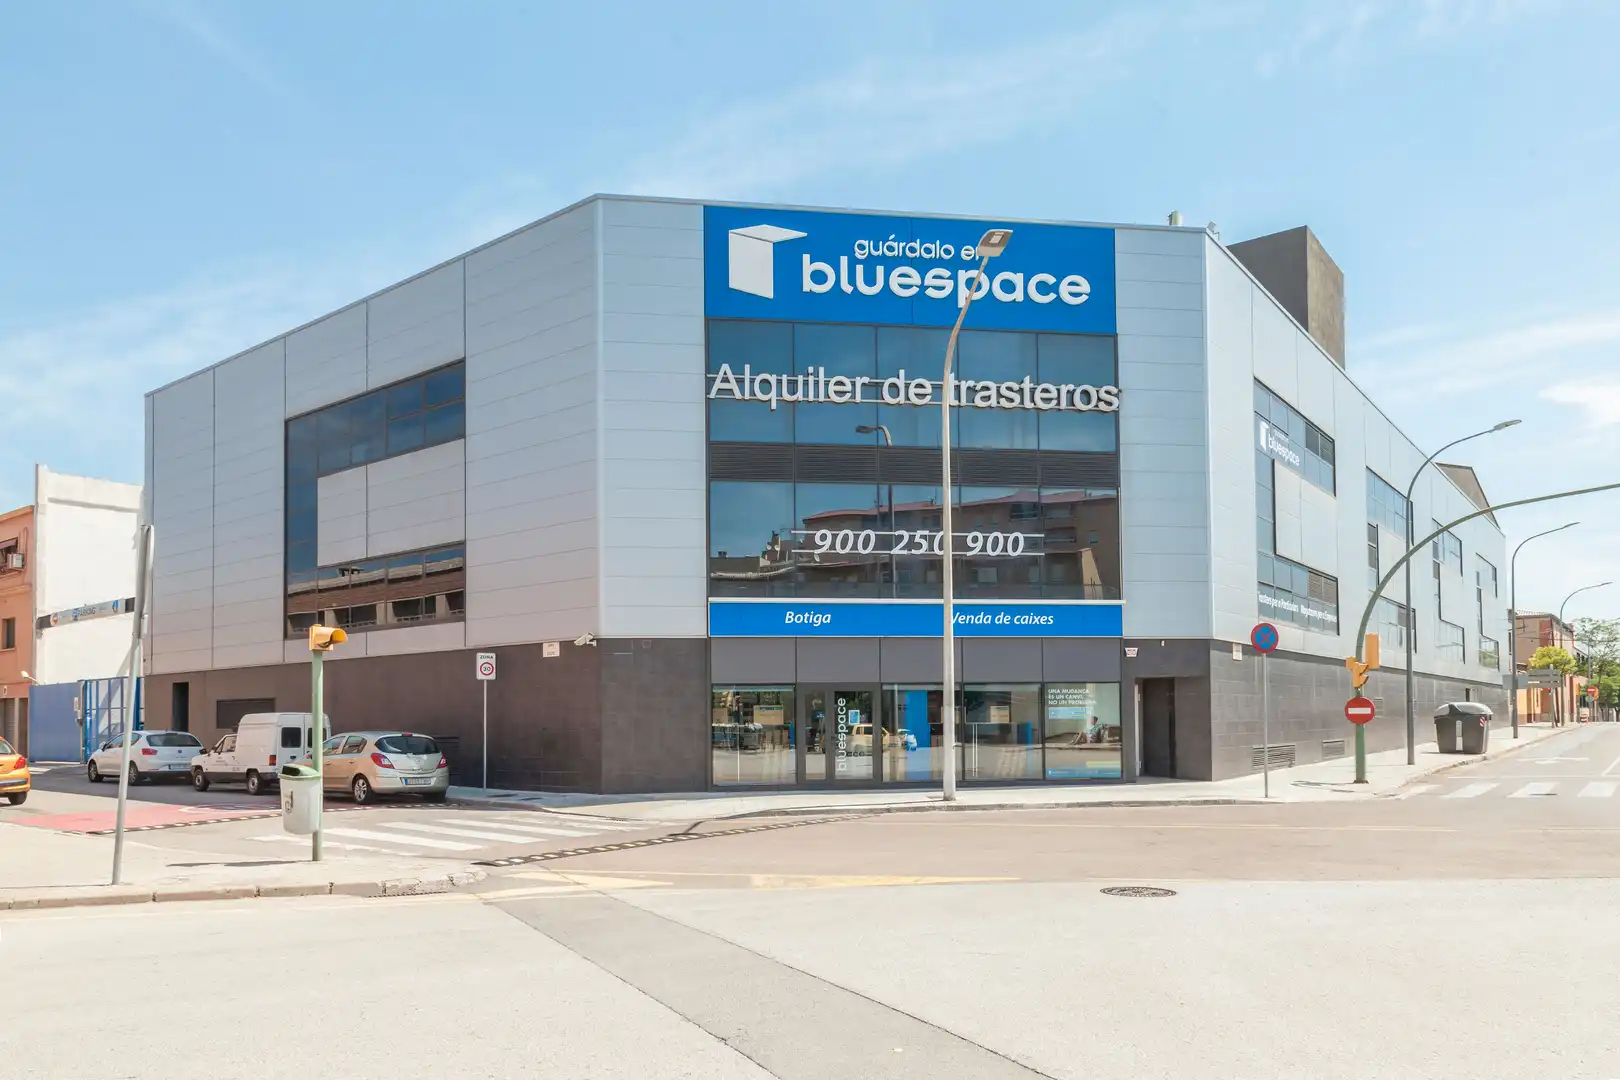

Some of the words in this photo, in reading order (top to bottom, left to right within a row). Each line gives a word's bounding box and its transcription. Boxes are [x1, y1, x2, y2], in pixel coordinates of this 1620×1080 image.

[854, 233, 955, 260] guárdalo
[802, 254, 1091, 308] bluespace
[709, 363, 869, 411] Alquiler
[882, 369, 932, 406] de
[948, 372, 1120, 412] trasteros
[814, 529, 876, 556] 900
[966, 531, 1025, 556] 900
[784, 610, 832, 627] Botiga
[995, 611, 1011, 625] de
[1014, 611, 1054, 625] caixes
[837, 697, 848, 771] bluespace
